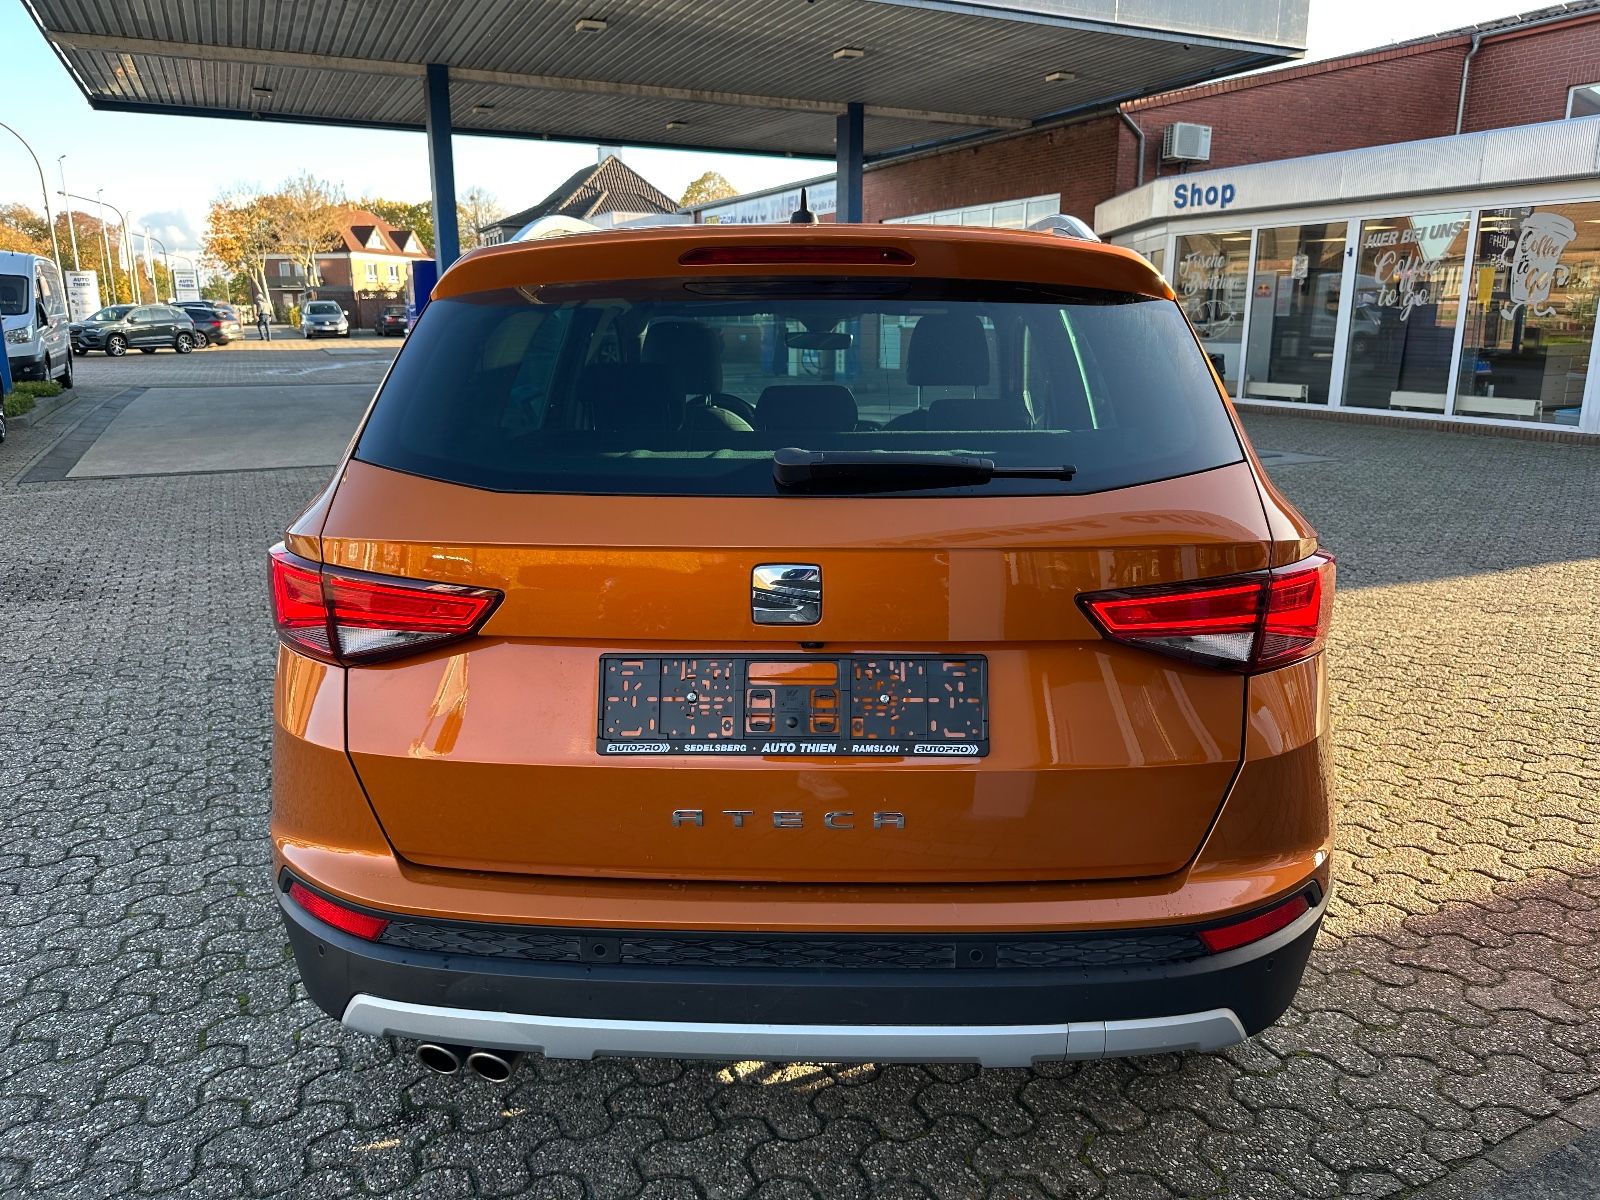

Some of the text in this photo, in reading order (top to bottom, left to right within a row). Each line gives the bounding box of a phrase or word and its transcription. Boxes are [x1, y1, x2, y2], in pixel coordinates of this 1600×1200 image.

[1173, 183, 1235, 209] Shop
[1365, 221, 1466, 248] HIER BEI UNS
[1180, 251, 1226, 276] Frische
[1374, 250, 1441, 293] Coffee
[1377, 285, 1430, 322] to go
[684, 744, 747, 752] SEDELSBERG
[761, 742, 796, 753] AUTO
[799, 742, 837, 753] THIEN
[852, 744, 899, 753] RAMSLOH
[671, 809, 906, 830] ATECA
